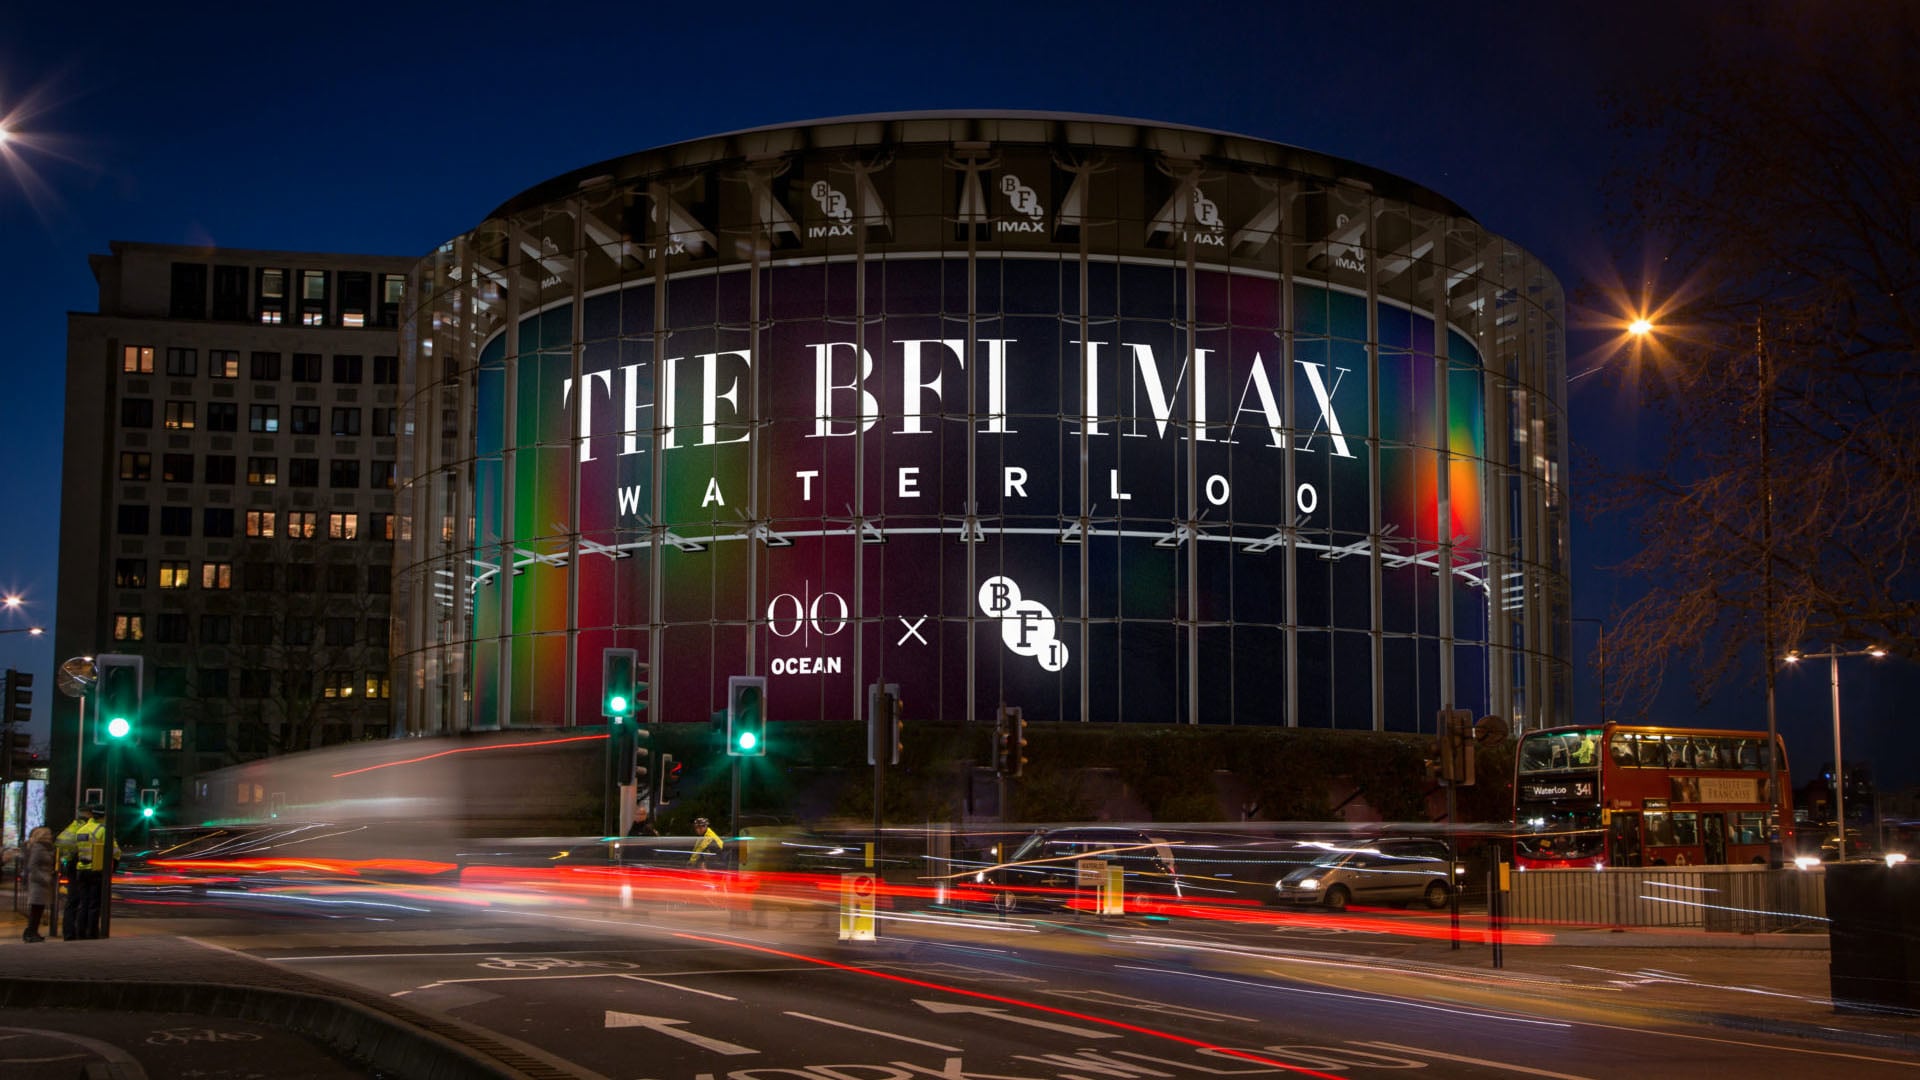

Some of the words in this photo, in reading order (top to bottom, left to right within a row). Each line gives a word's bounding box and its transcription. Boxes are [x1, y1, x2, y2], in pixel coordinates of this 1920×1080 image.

[812, 181, 852, 223] BFI
[1003, 176, 1042, 219] BFI
[809, 224, 854, 239] IMAX
[997, 221, 1045, 233] IMAX
[562, 349, 751, 463] THE
[804, 338, 1018, 438] BFI
[1069, 339, 1358, 459] IMAX
[617, 466, 1318, 516] WATERLOO
[982, 577, 1065, 670] BFI
[771, 656, 842, 675] OCEAN
[1533, 786, 1567, 796] Waterloo
[1575, 783, 1592, 796] 341
